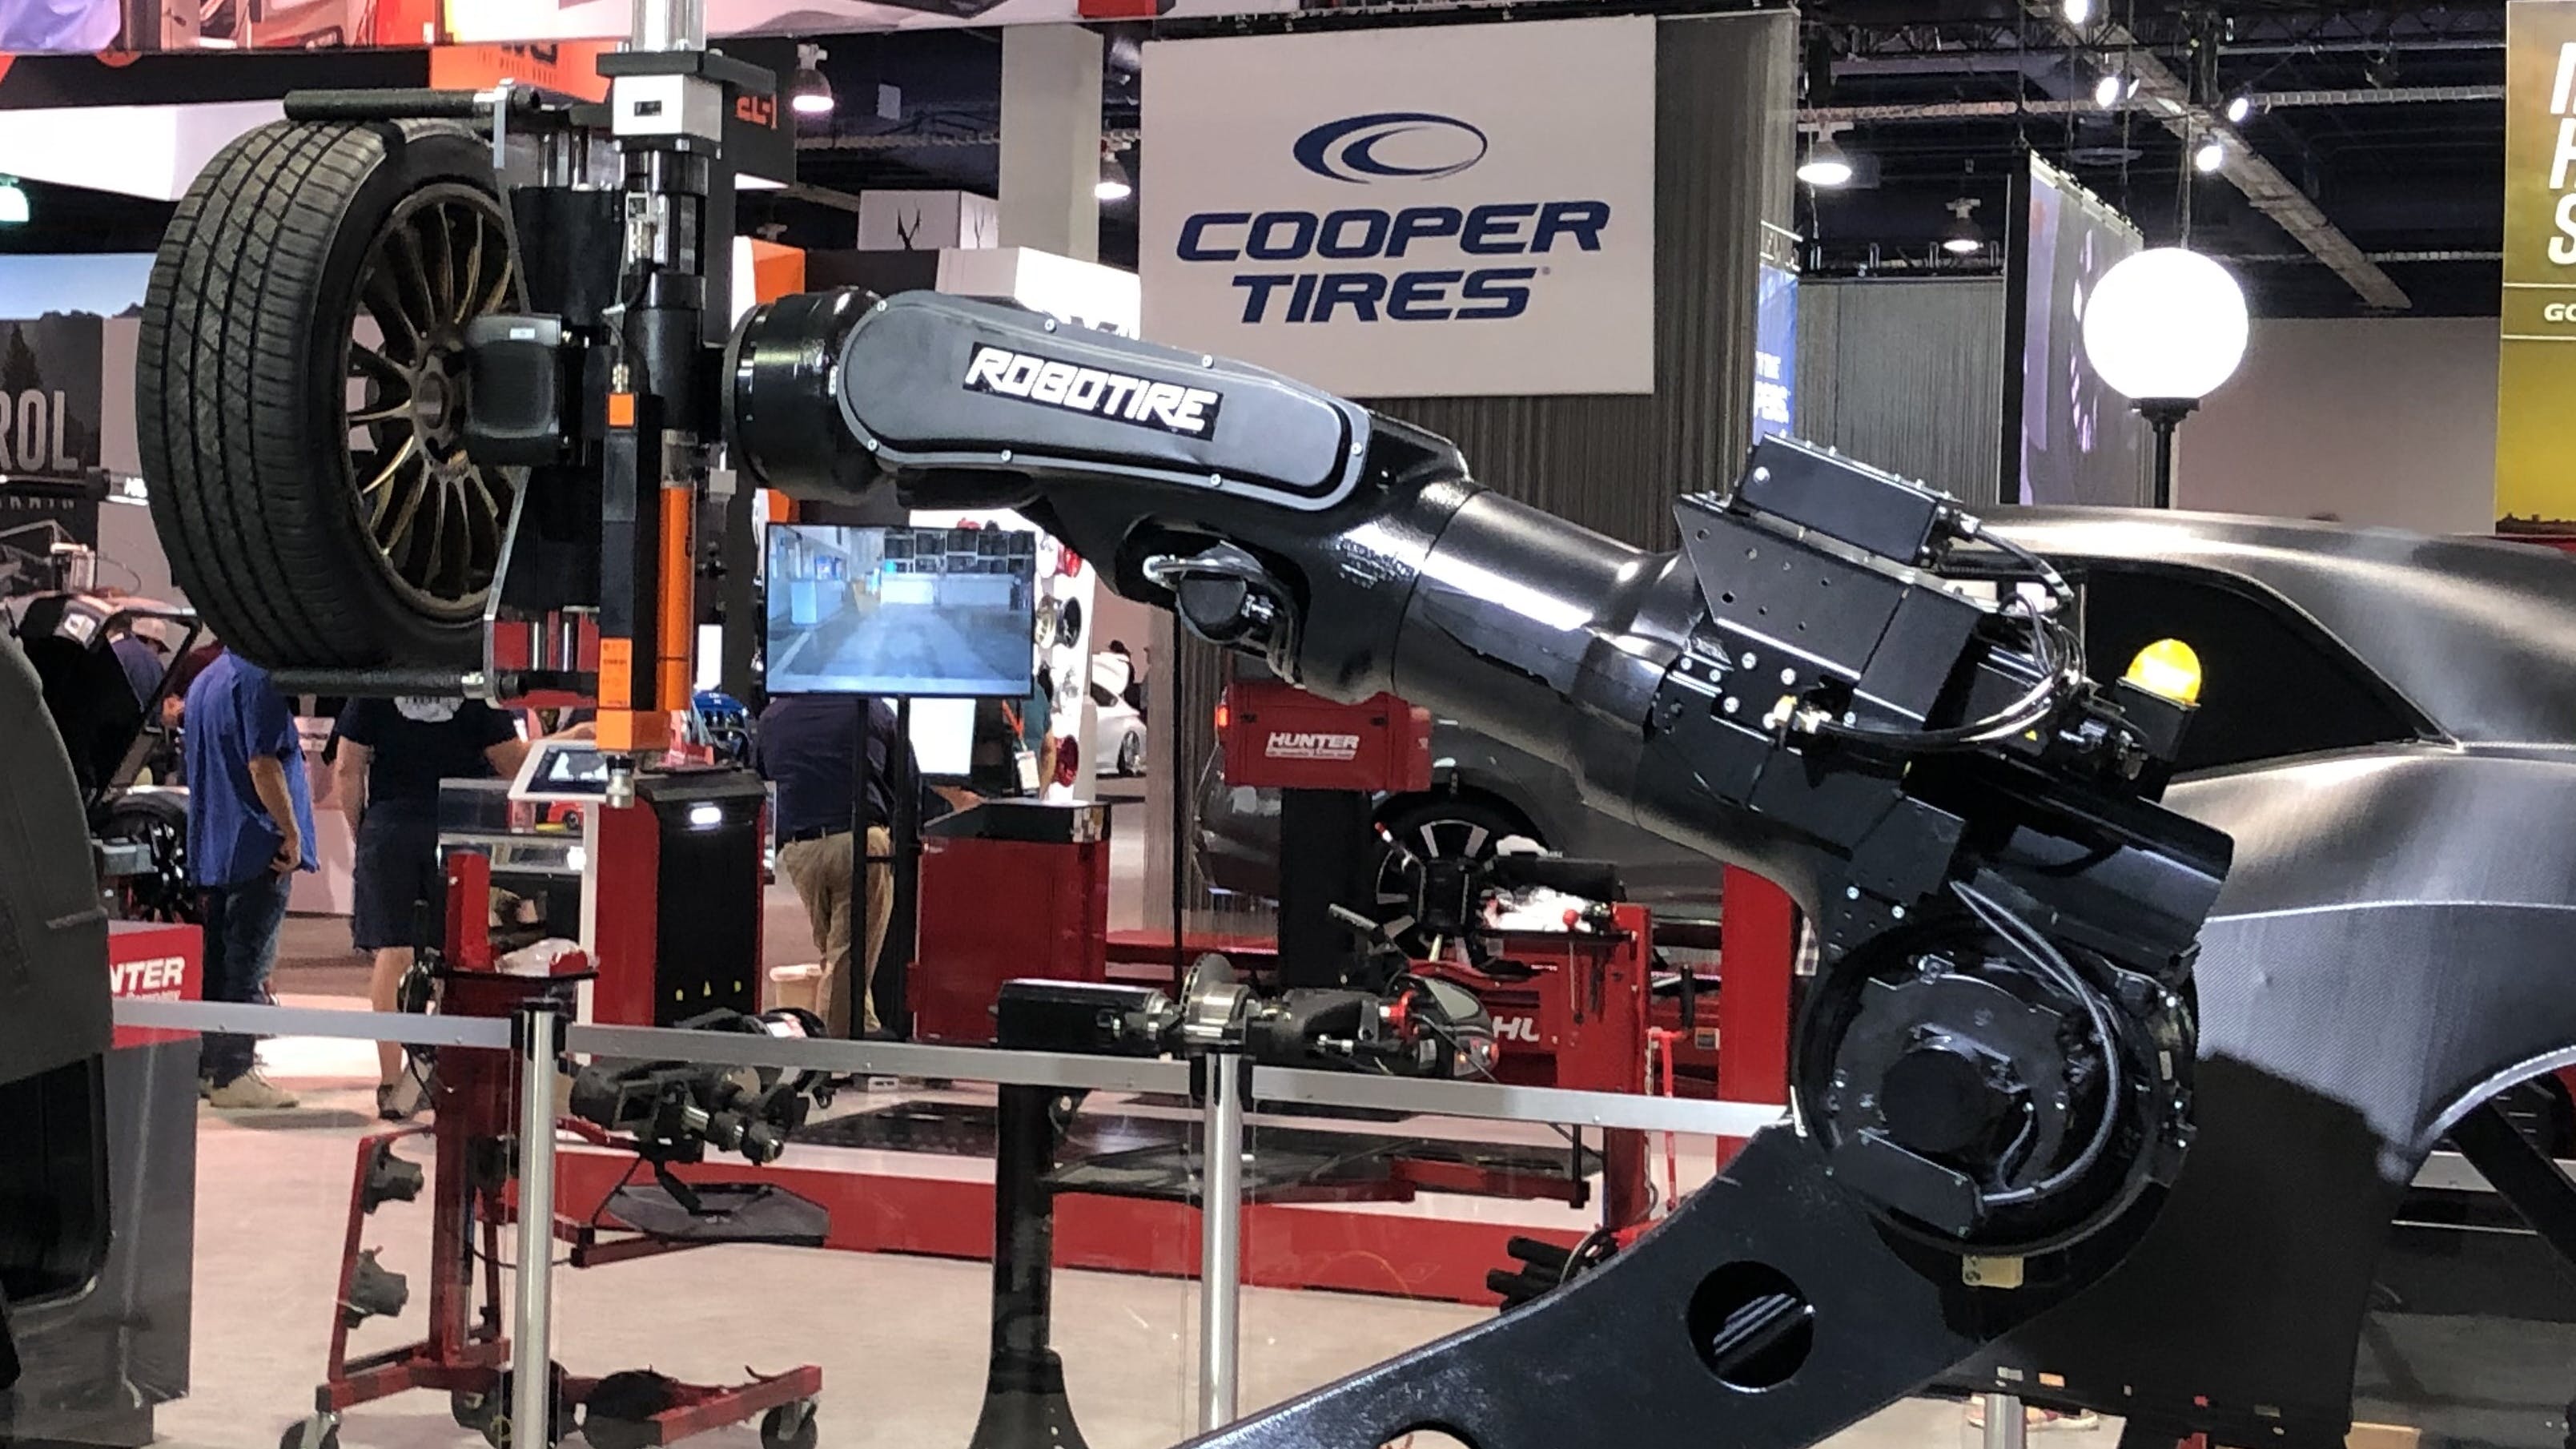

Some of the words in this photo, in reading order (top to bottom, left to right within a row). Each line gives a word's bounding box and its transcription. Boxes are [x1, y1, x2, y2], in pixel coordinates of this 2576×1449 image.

[1176, 200, 1611, 261] COOPER
[1231, 267, 1537, 324] TIRES
[964, 346, 1219, 432] ROBOTIRE
[1268, 731, 1360, 750] HUNTER
